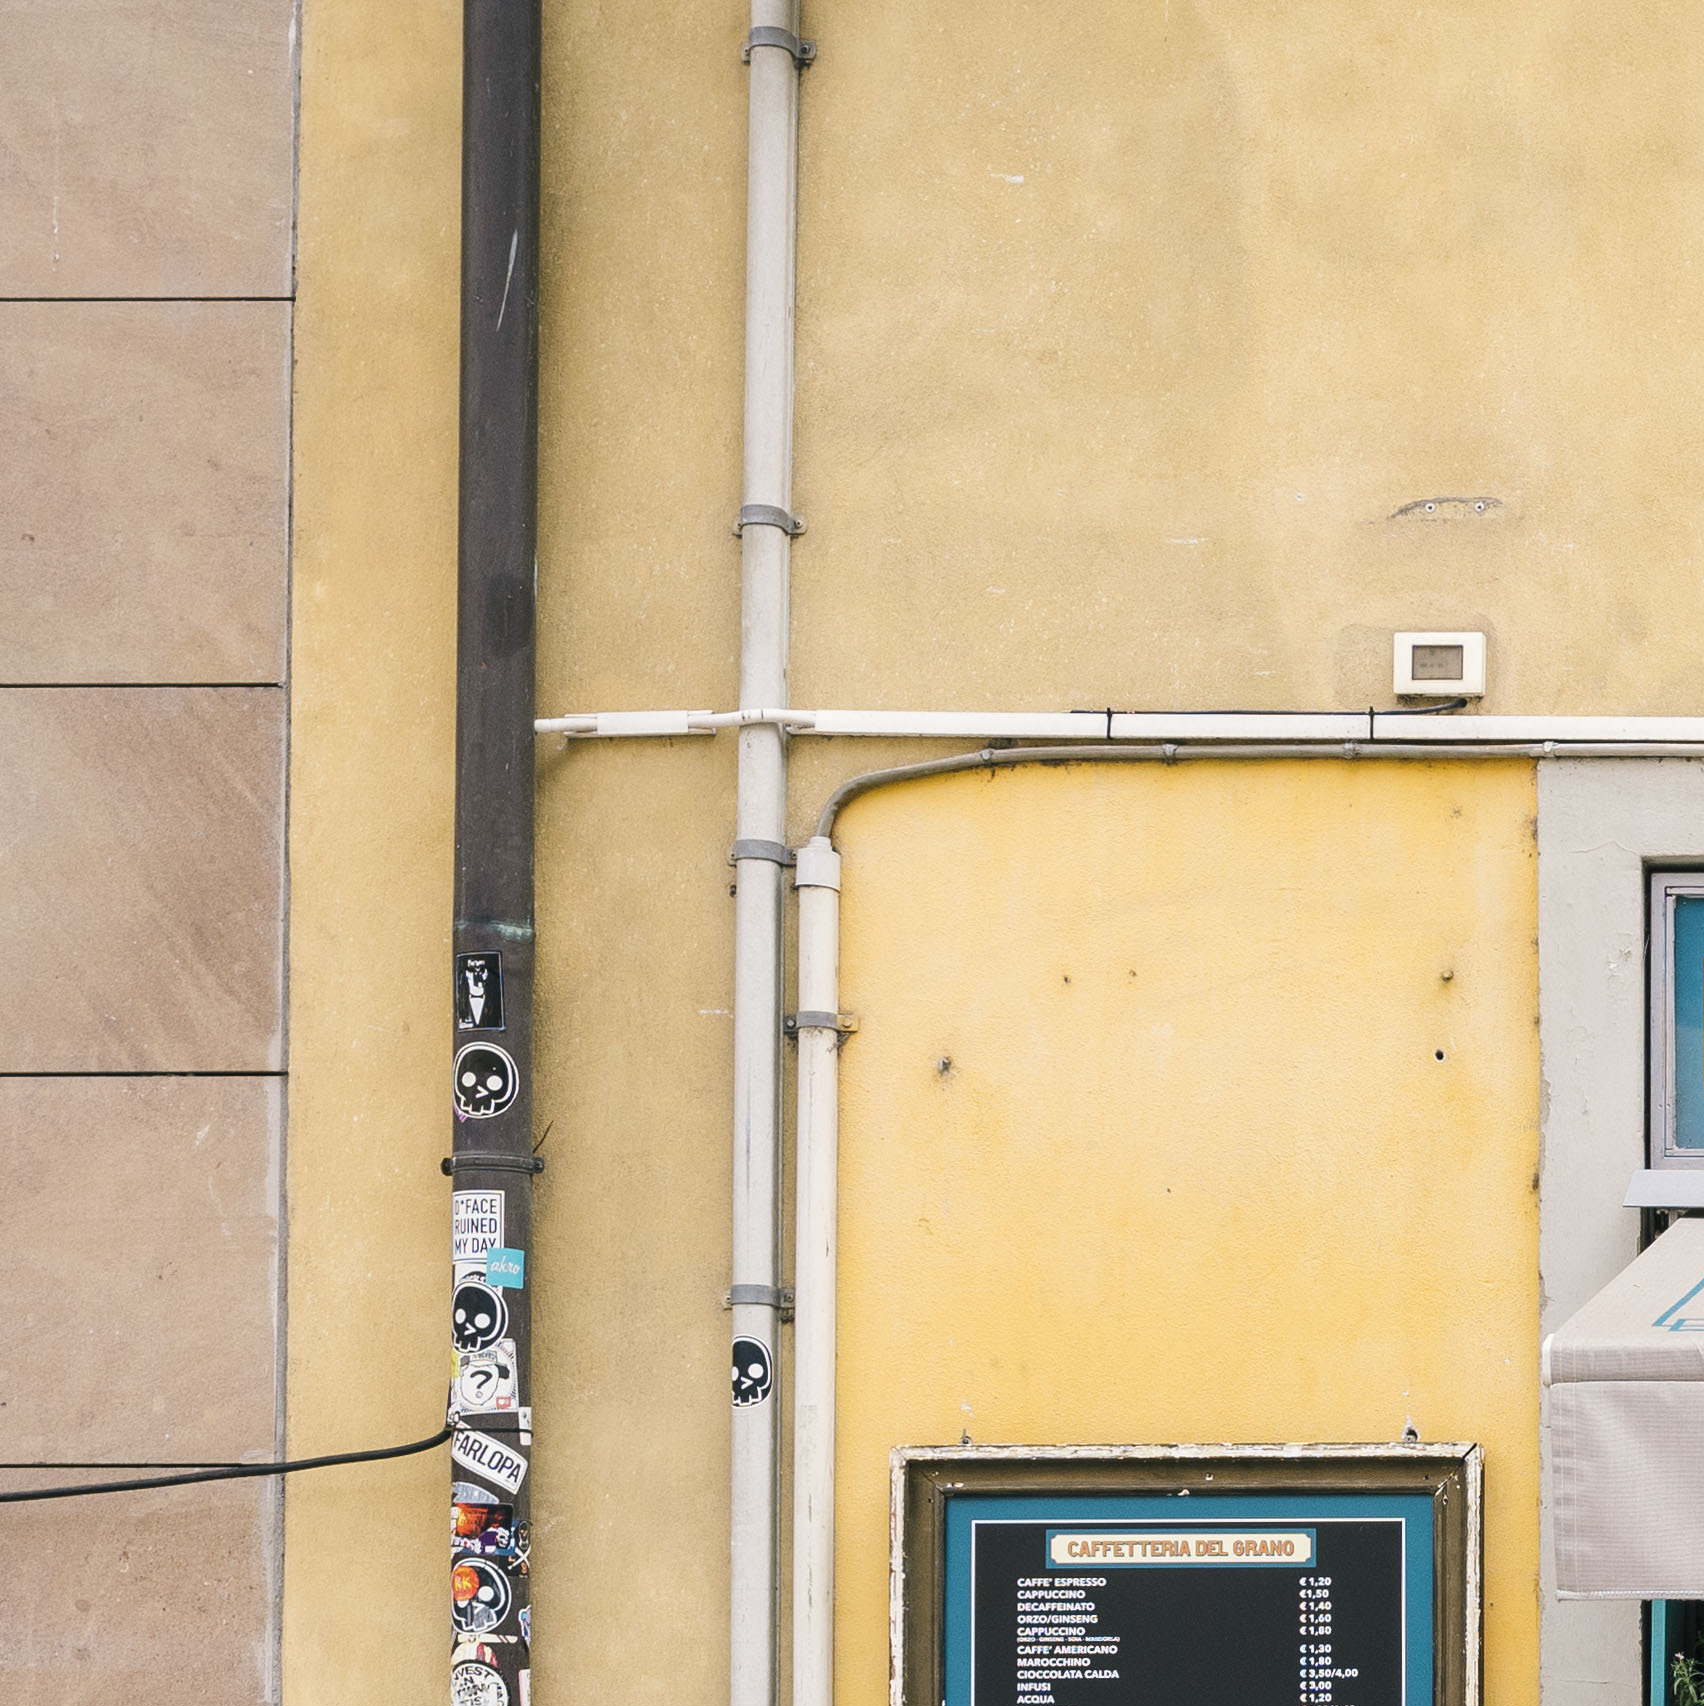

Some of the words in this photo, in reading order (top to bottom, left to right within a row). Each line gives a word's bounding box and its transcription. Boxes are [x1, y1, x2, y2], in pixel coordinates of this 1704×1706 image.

[455, 1218, 497, 1234] RUINED
[455, 1238, 468, 1254] MY
[472, 1237, 496, 1253] DAY
[453, 1431, 521, 1483] FARLOPA
[1067, 1540, 1191, 1558] CAFFETTERIA
[1195, 1540, 1228, 1556] DEL
[1233, 1539, 1295, 1556] GRANO
[1017, 1578, 1052, 1587] CAFFE'
[1054, 1578, 1107, 1587] ESPRESSO
[1299, 1577, 1306, 1587] €
[1309, 1577, 1332, 1587] 1,20
[1017, 1590, 1085, 1599] CAPPUCCINO
[1299, 1589, 1329, 1599] €1,50
[1017, 1602, 1095, 1612] DECAFFEINATO
[1299, 1601, 1307, 1611] €
[1309, 1601, 1332, 1611] 1,40
[1017, 1615, 1098, 1624] ORZO/GINSENG
[1299, 1614, 1307, 1623] €
[1309, 1614, 1332, 1623] 1,60
[1017, 1627, 1085, 1636] CAPPUCCINO
[1299, 1626, 1307, 1635] €
[1309, 1626, 1332, 1635] 1,80
[1017, 1645, 1052, 1655] CAFFE'
[1054, 1645, 1118, 1655] AMERICANO
[1299, 1644, 1307, 1654] €
[1309, 1644, 1332, 1654] 1,30
[1017, 1658, 1091, 1667] MAROCCHINO
[1299, 1657, 1307, 1666] €
[1309, 1657, 1332, 1666] 1,80
[1017, 1670, 1083, 1679] CIOCCOLATA
[1085, 1670, 1119, 1679] CALDA
[1299, 1669, 1307, 1678] €
[1309, 1669, 1358, 1678] 3,50/4,00
[1017, 1683, 1051, 1692] INFUSI
[1299, 1681, 1307, 1691] €
[1309, 1681, 1332, 1691] 3,00
[1017, 1695, 1055, 1704] ACQUA
[1299, 1694, 1307, 1703] €
[1309, 1694, 1332, 1703] 1,20
